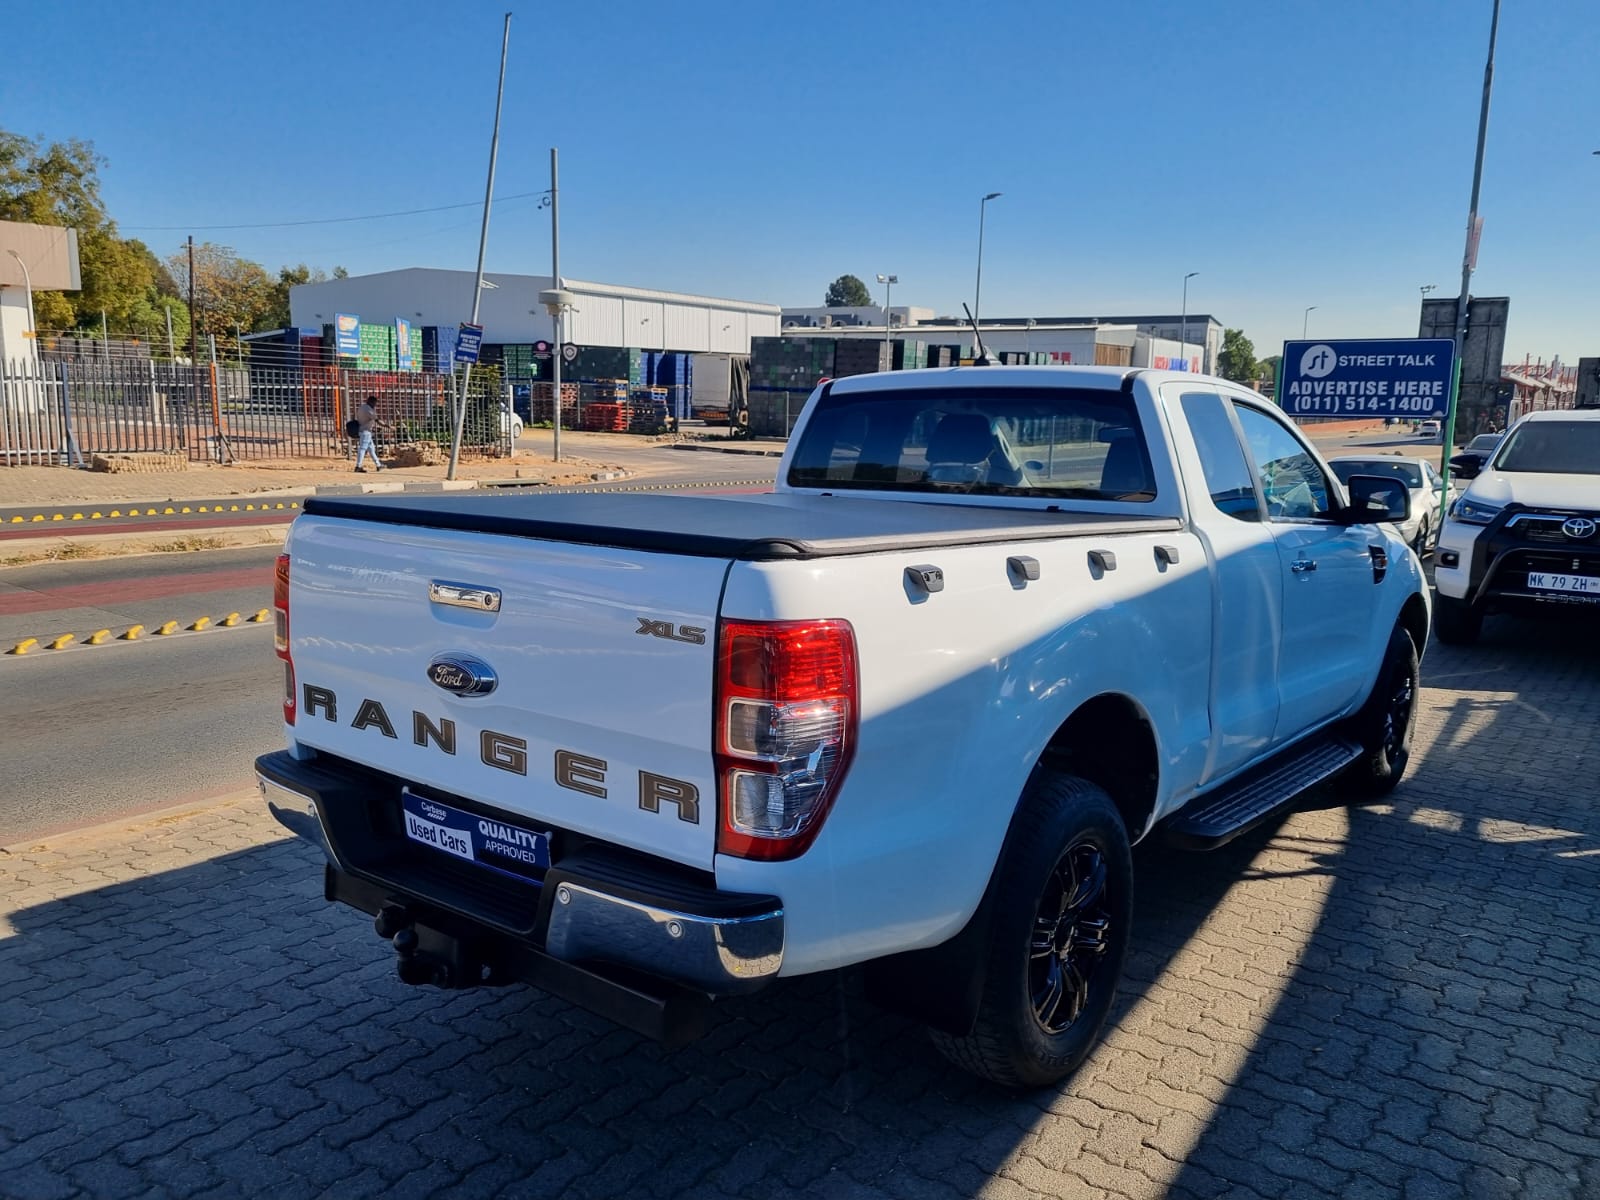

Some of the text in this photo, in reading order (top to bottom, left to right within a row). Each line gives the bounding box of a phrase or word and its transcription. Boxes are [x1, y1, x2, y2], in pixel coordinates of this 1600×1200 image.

[1338, 354, 1436, 366] STREET TALK
[1289, 381, 1443, 396] ADVERTISE HERE
[1294, 396, 1434, 413] (011) 514-1400
[1551, 576, 1566, 588] 79
[1572, 578, 1587, 590] ZH
[635, 617, 706, 645] XLS
[434, 665, 463, 686] Ford
[303, 683, 700, 824] RANGER
[421, 801, 447, 817] Carbase
[409, 818, 467, 854] Used Cars
[478, 820, 537, 849] QUALITY
[485, 839, 536, 864] APPROVED
